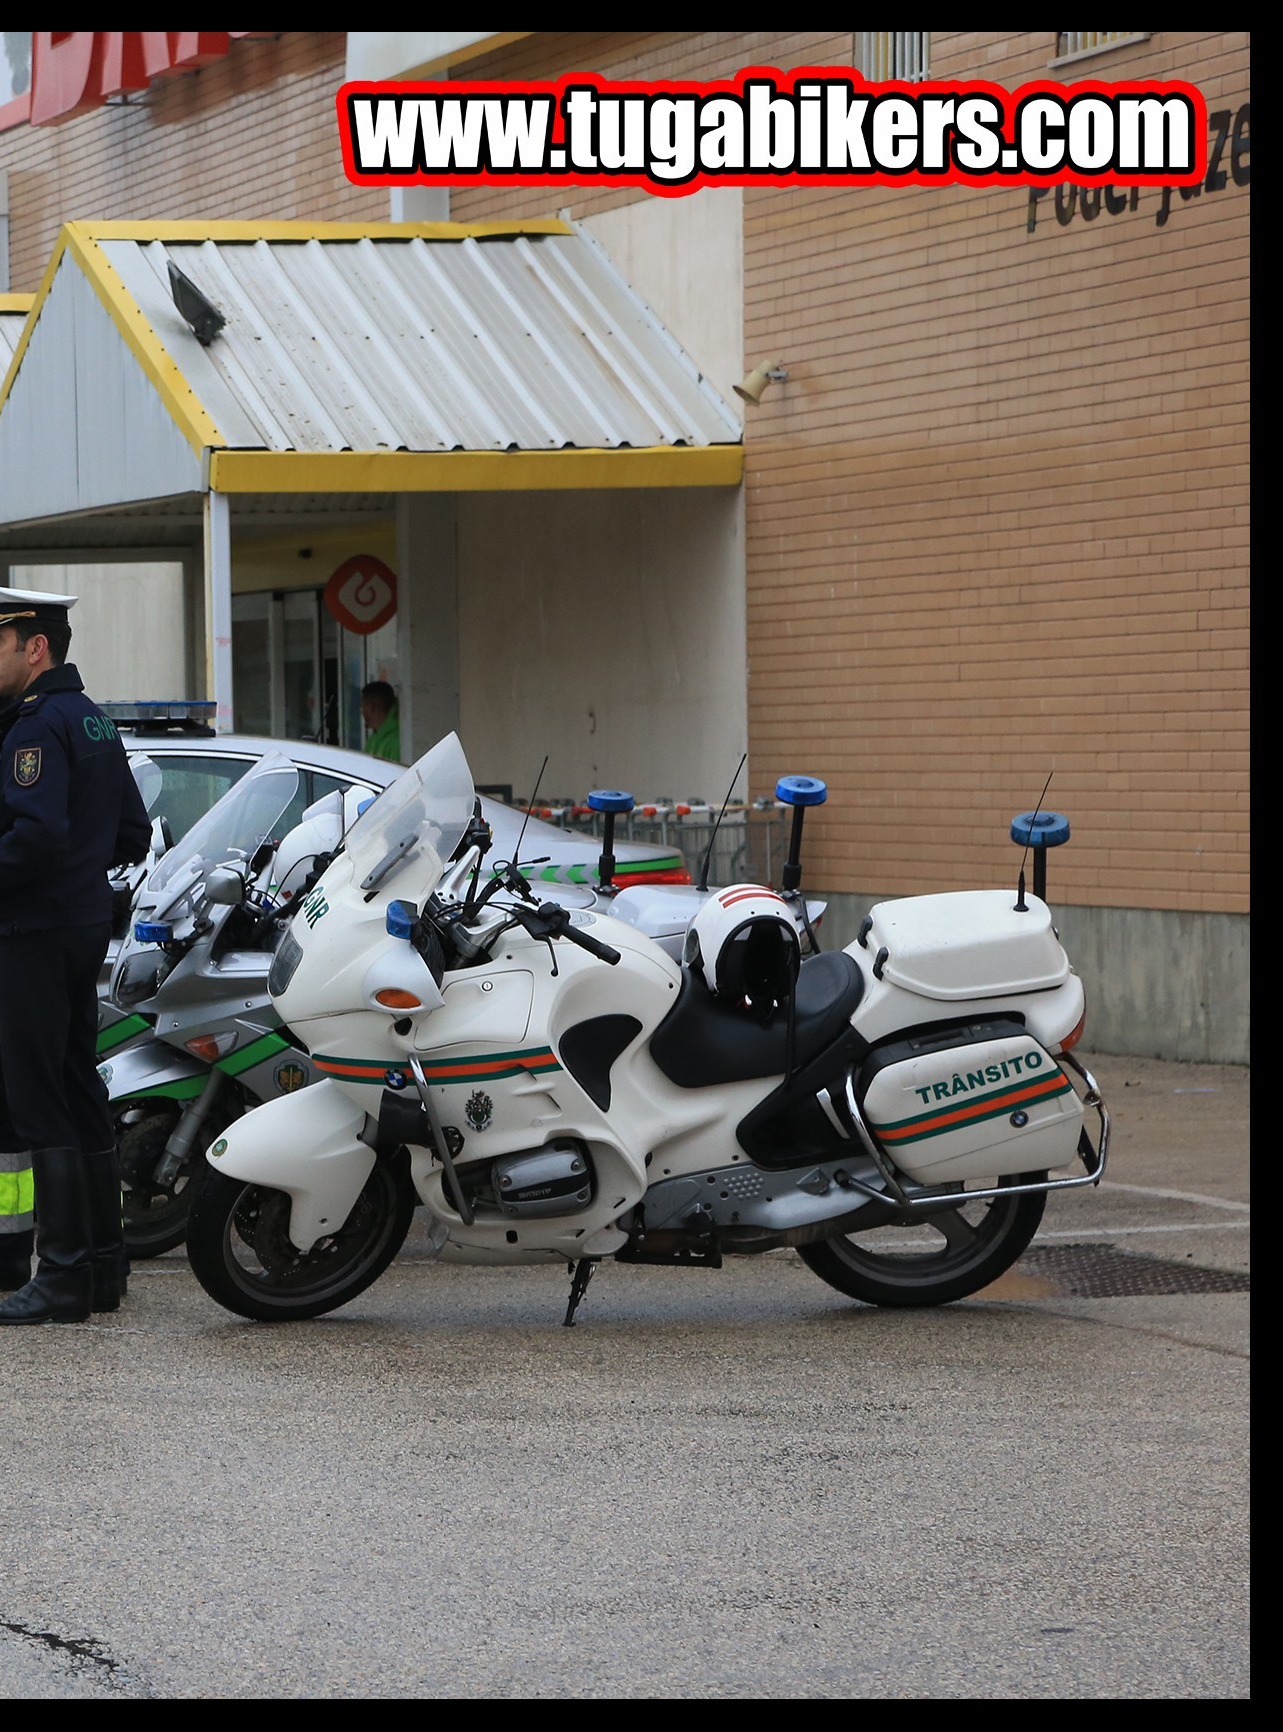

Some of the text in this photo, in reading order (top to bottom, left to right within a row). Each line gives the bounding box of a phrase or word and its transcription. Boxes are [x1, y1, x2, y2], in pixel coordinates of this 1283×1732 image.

[83, 716, 120, 741] GNR
[304, 886, 330, 930] GNR
[915, 1051, 1043, 1104] TRÂNSITO
